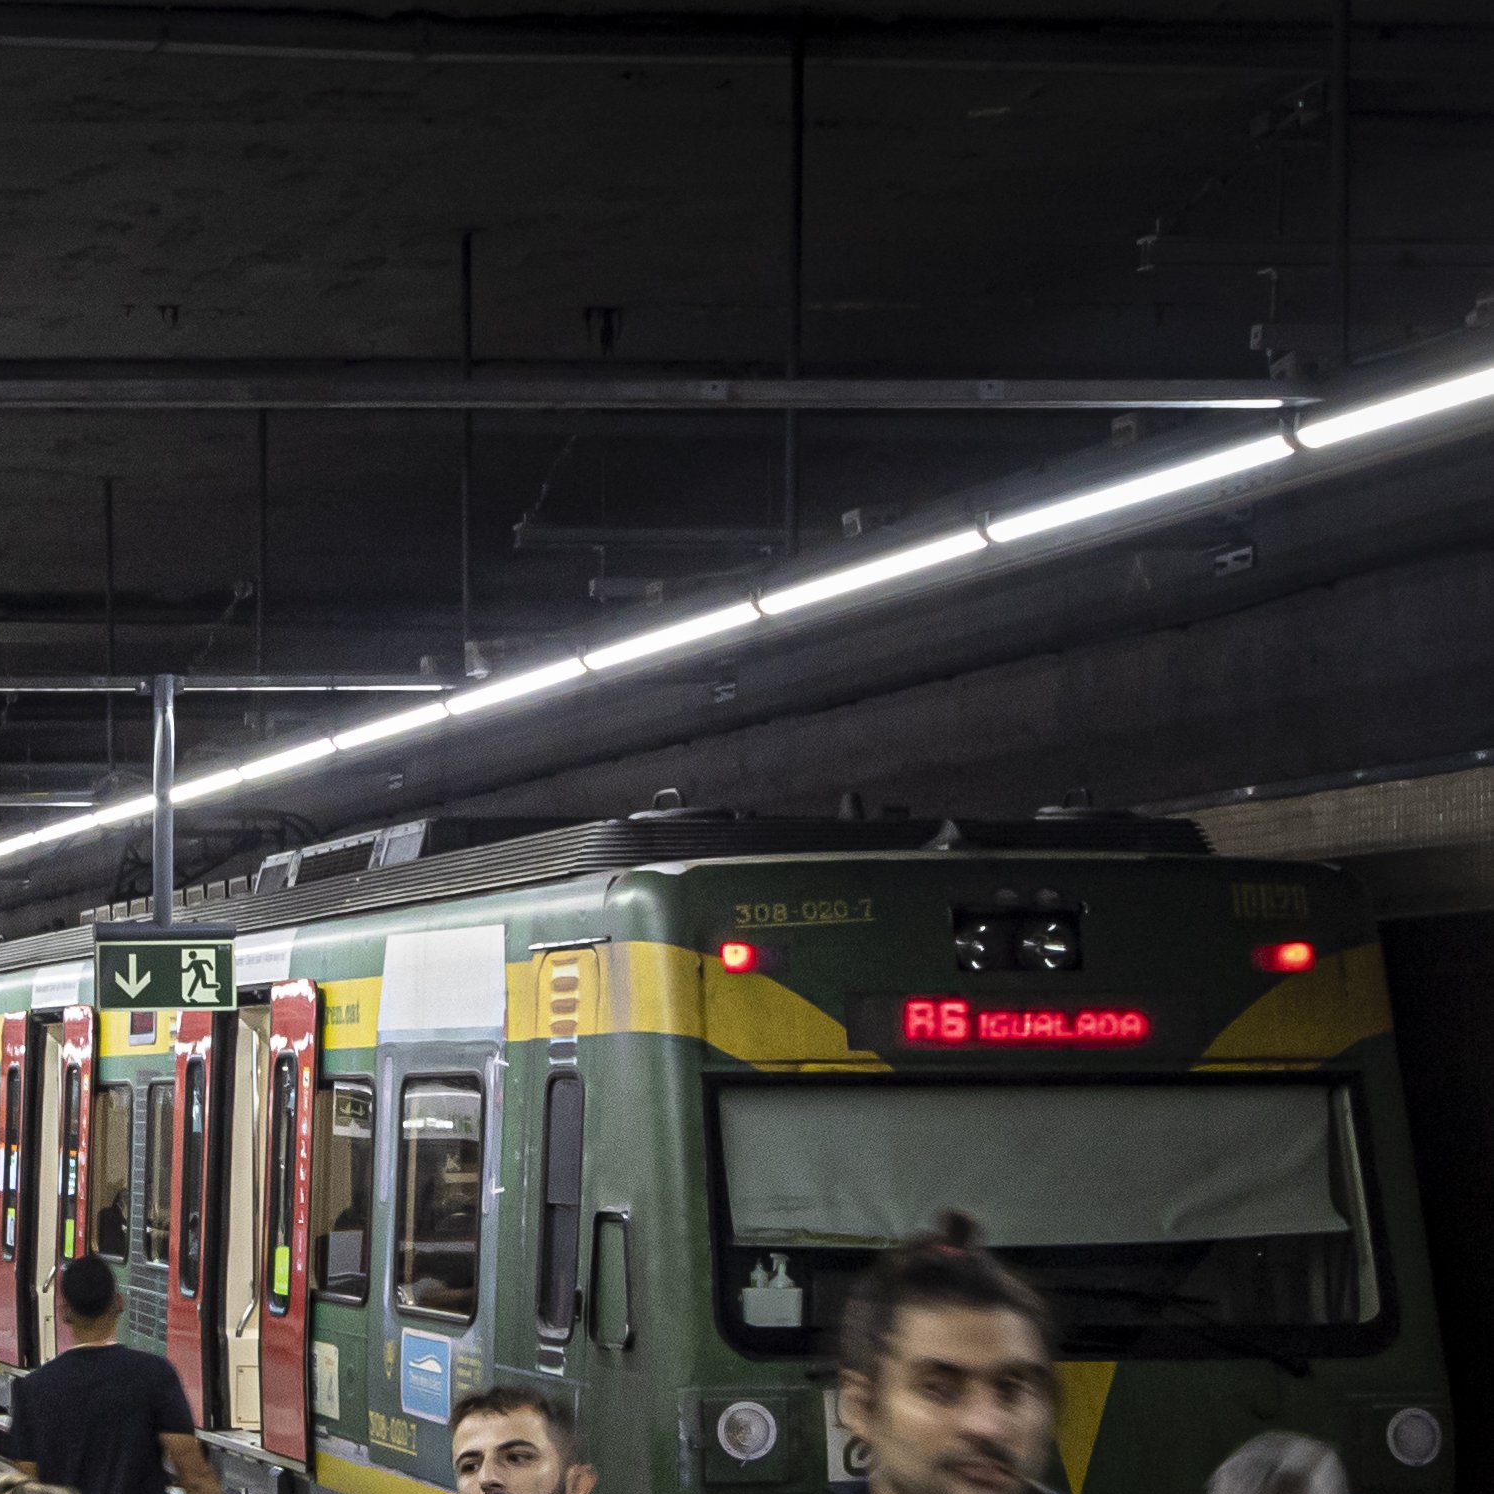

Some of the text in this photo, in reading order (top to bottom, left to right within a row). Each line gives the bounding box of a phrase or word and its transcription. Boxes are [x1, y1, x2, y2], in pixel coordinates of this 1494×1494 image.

[735, 898, 875, 926] 308-020-7
[905, 1001, 1148, 1040] R6 IGUALADA
